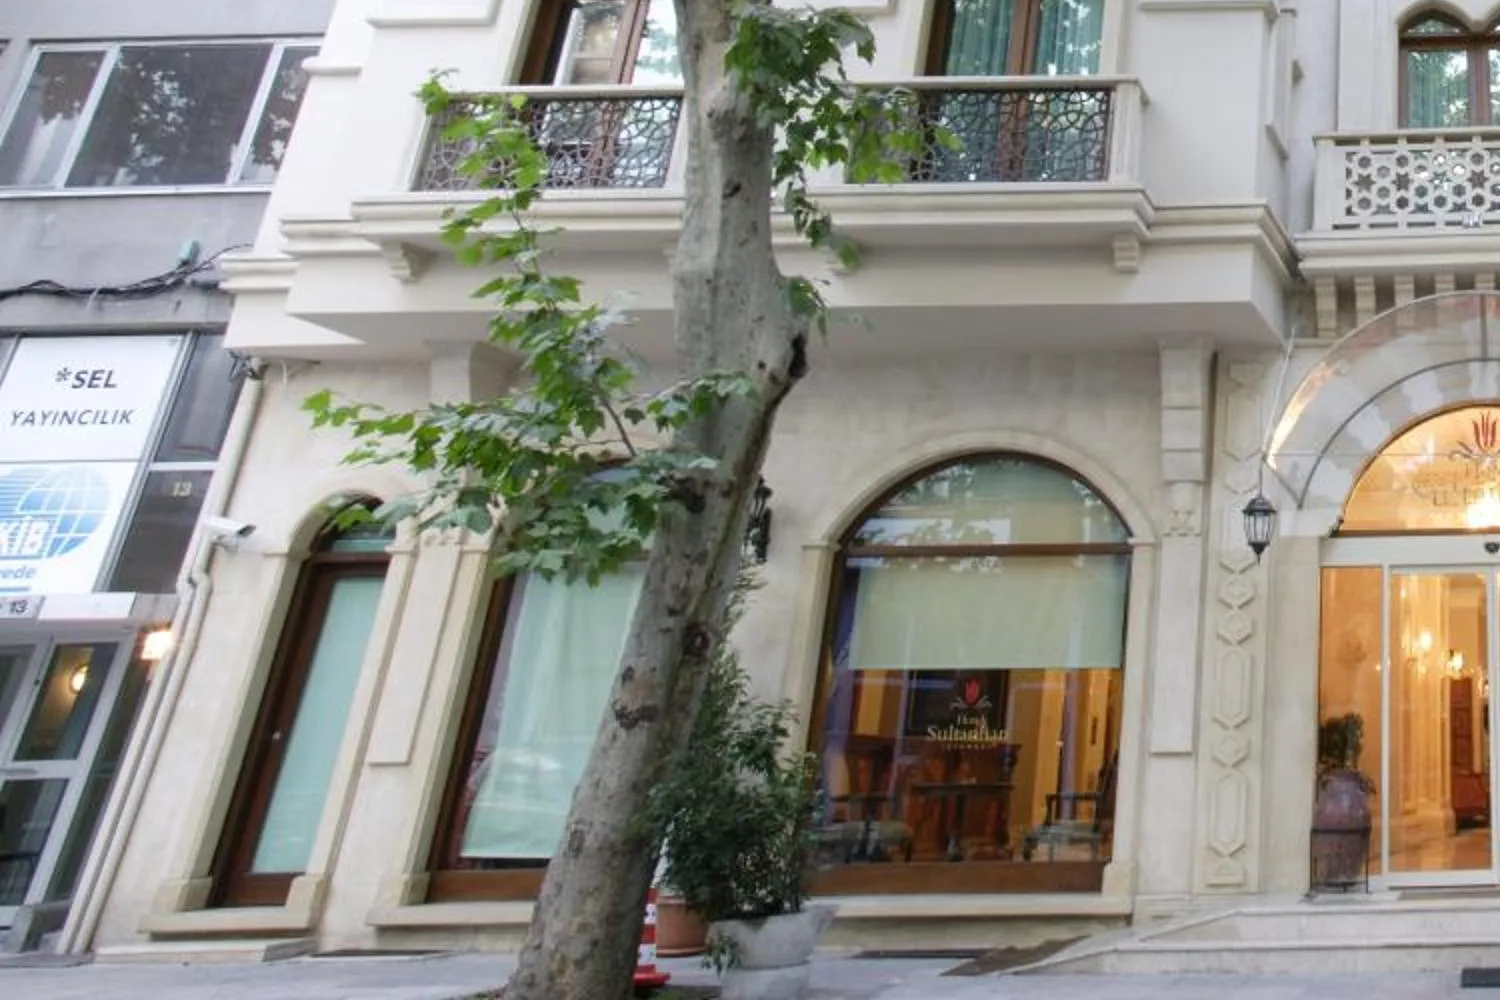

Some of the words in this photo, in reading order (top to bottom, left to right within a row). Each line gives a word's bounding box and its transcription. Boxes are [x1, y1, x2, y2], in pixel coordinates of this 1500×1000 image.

[71, 370, 118, 389] SEL
[9, 409, 135, 427] YAYINCILIK
[172, 481, 192, 497] 13
